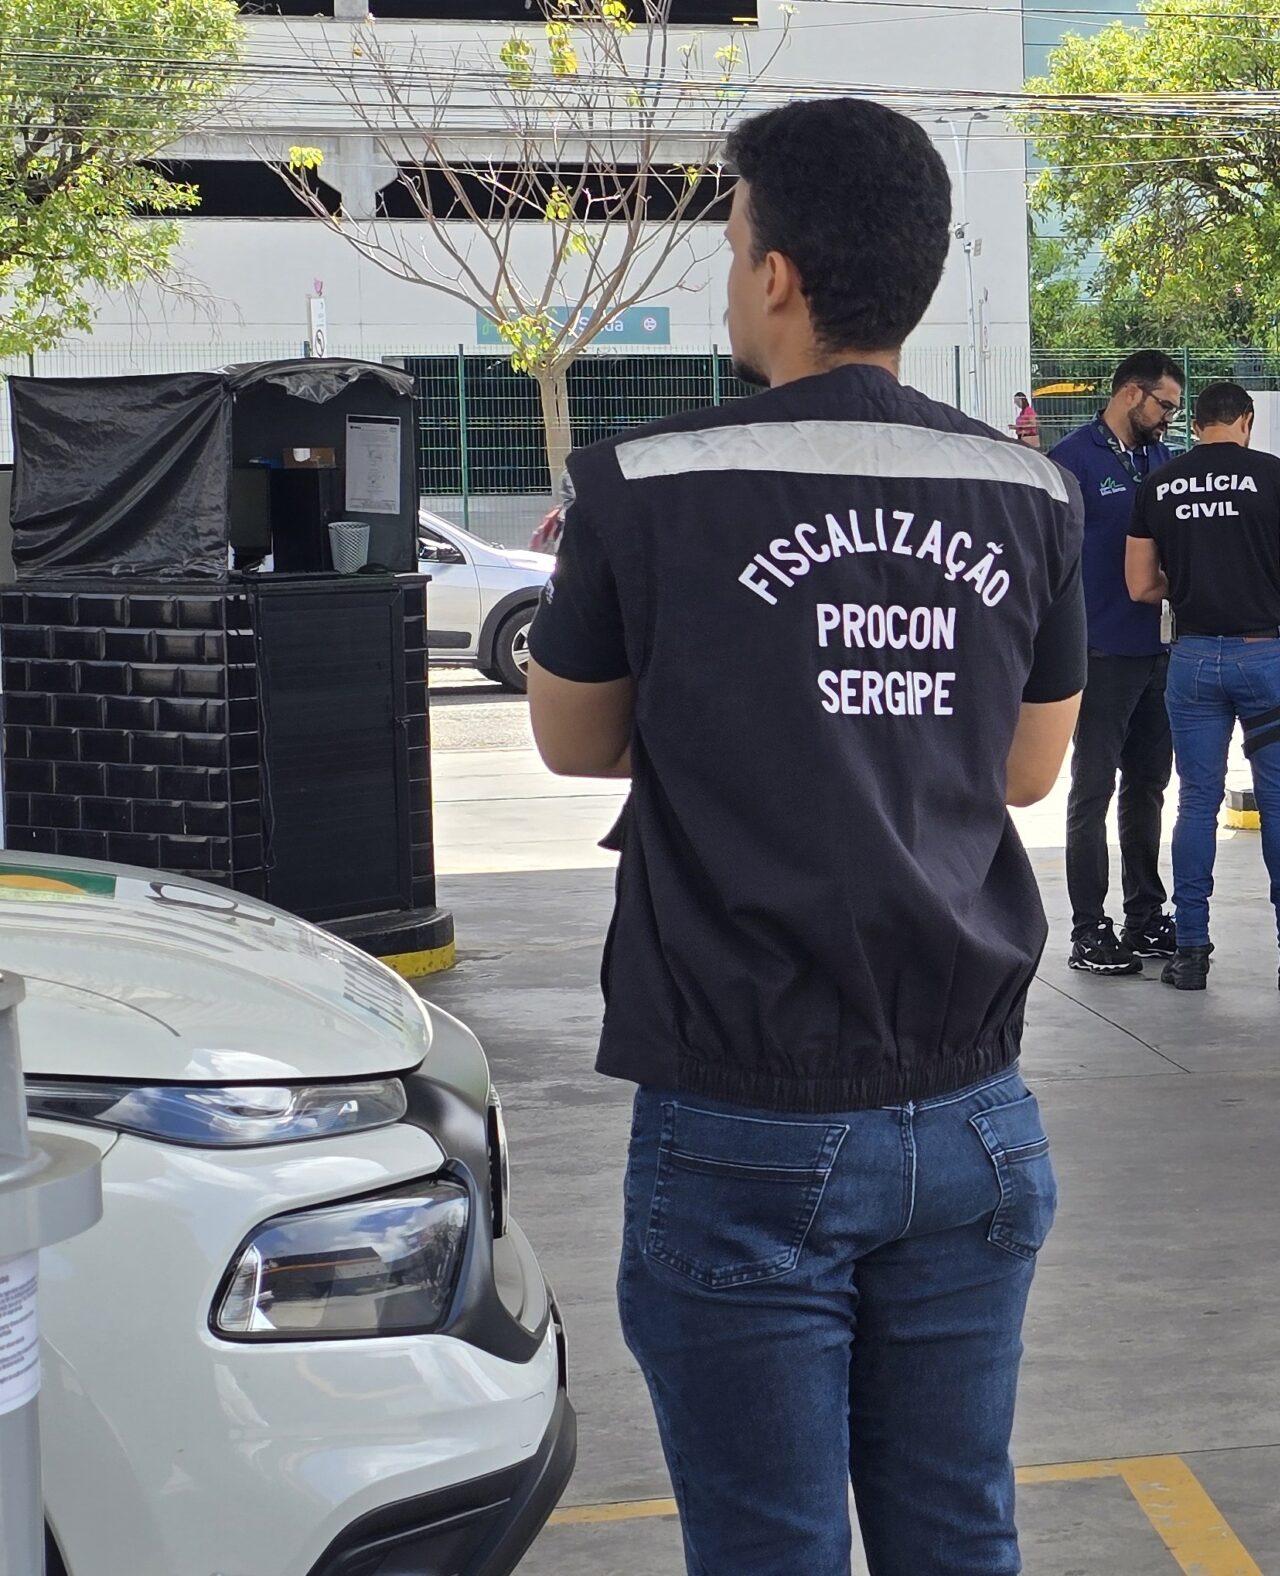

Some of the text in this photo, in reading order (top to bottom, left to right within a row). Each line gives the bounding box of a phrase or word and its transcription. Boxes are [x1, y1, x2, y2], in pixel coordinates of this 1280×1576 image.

[1156, 472, 1258, 501] POLÍCIA
[1175, 501, 1239, 520] CIVIL
[738, 508, 1010, 607] FISCALIZAÇÃO
[816, 603, 957, 650] PROCON
[817, 669, 956, 716] SERGIPE
